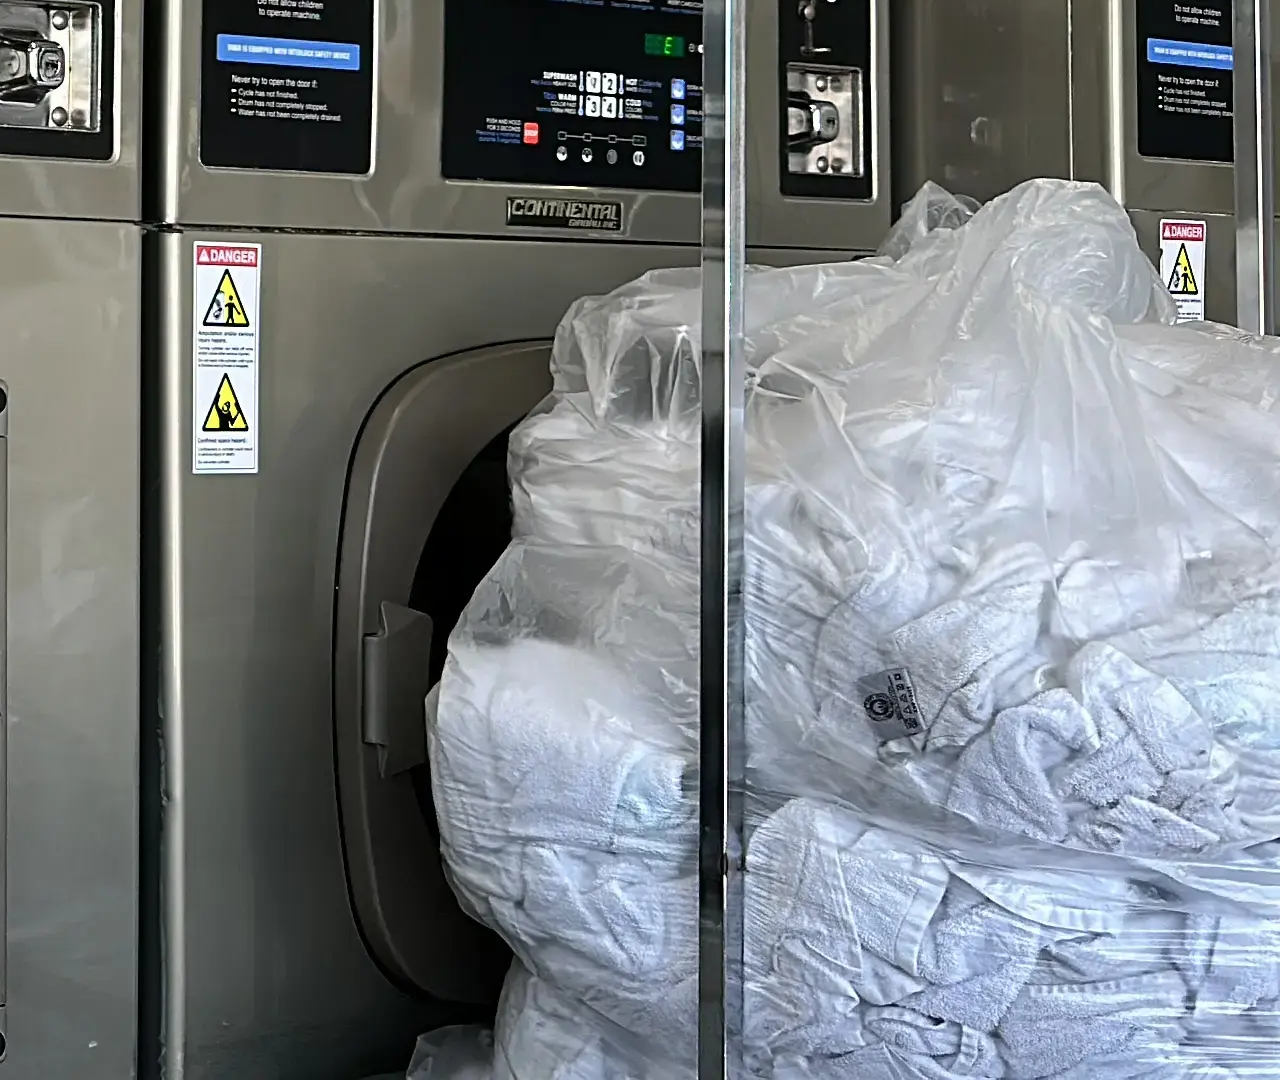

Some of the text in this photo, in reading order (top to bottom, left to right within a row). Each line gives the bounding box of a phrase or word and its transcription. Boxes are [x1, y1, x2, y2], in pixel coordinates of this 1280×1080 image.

[512, 200, 618, 220] CONTINENTAL
[1171, 226, 1202, 237] DANGER
[210, 250, 256, 263] DANGER
